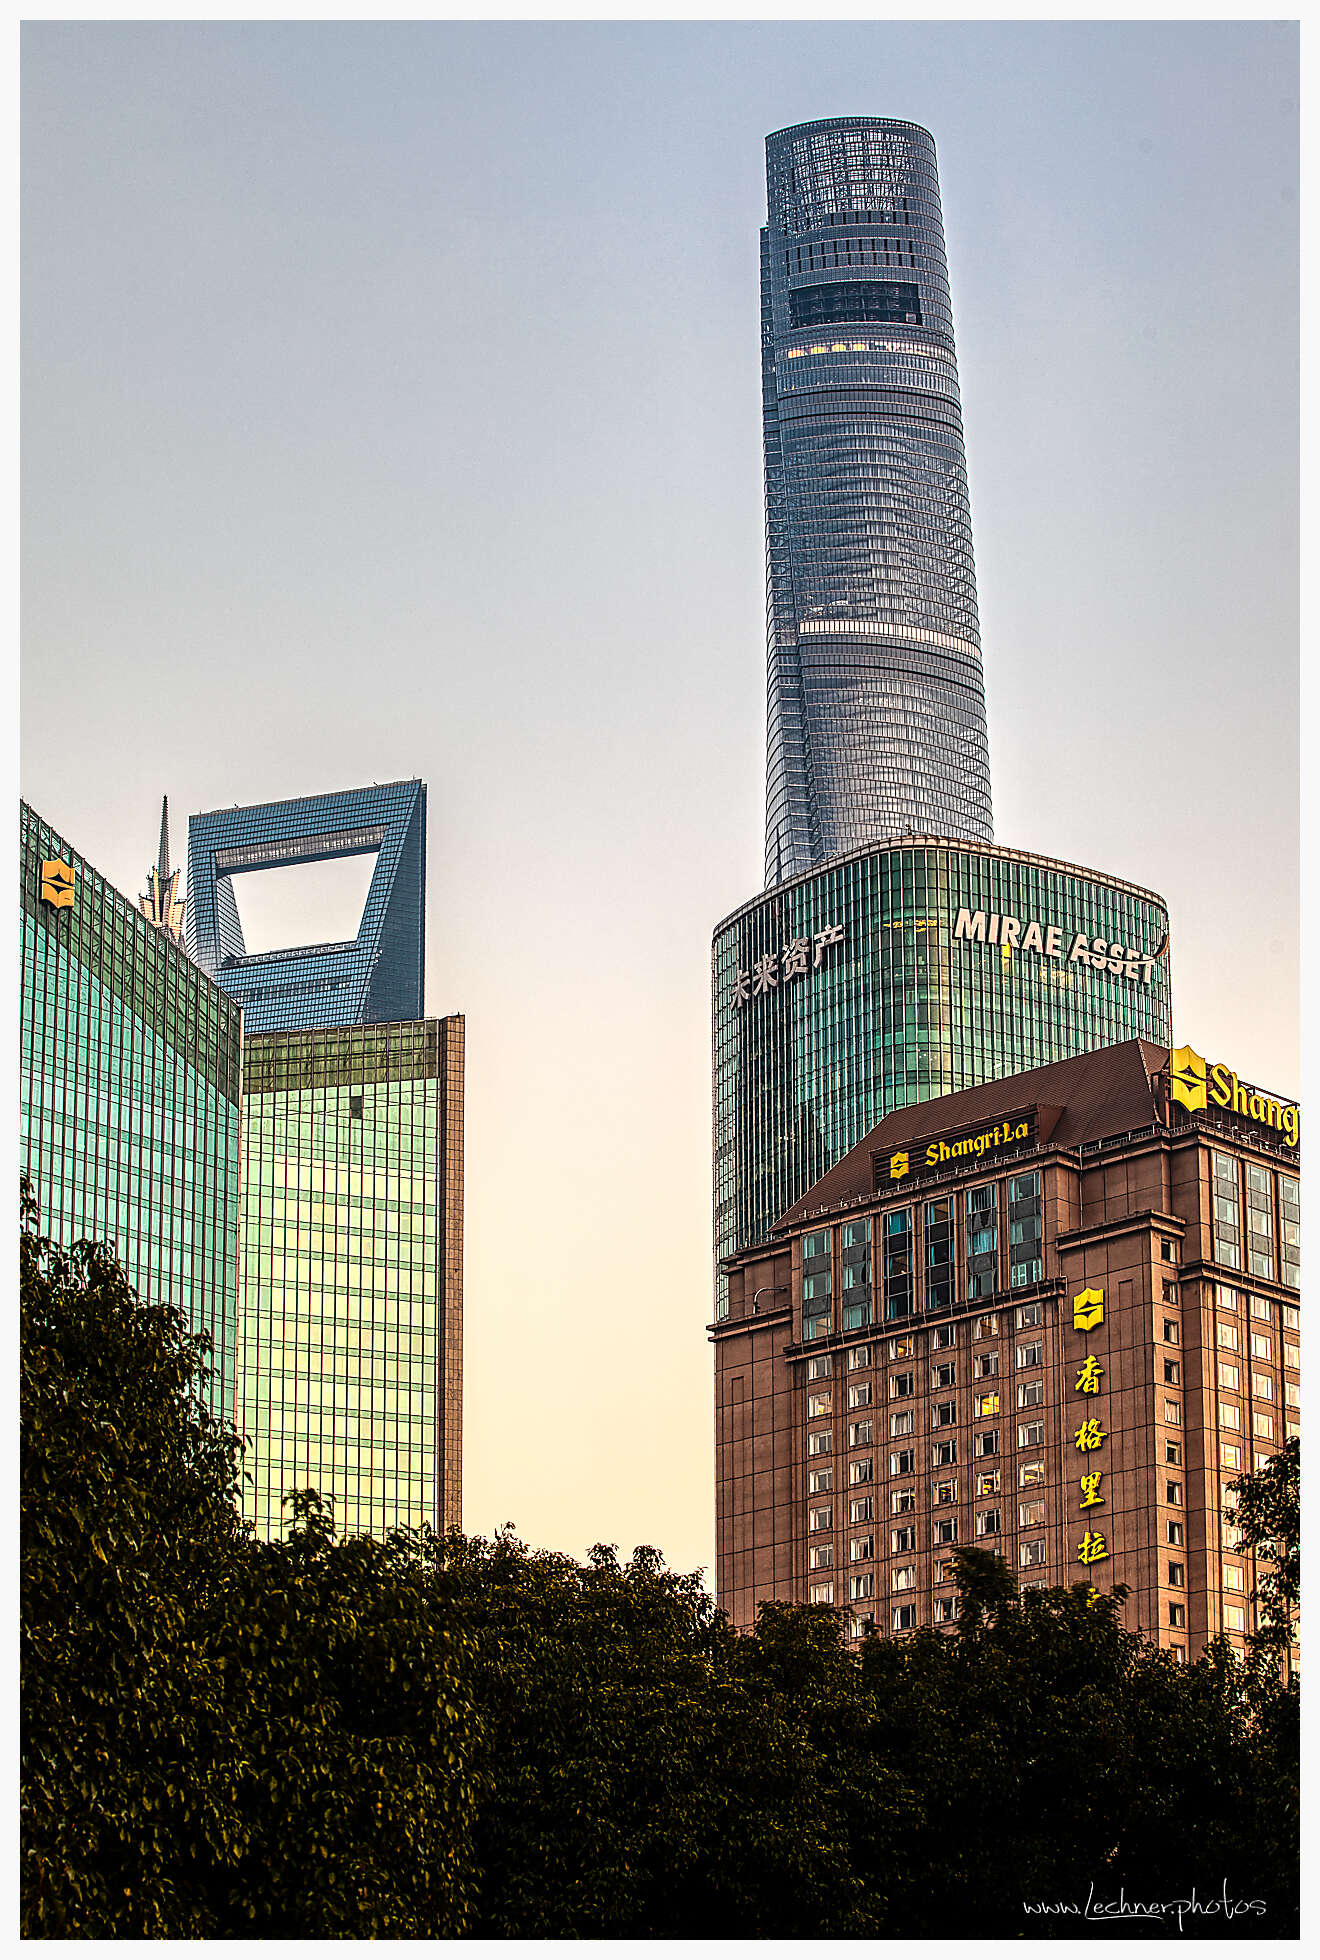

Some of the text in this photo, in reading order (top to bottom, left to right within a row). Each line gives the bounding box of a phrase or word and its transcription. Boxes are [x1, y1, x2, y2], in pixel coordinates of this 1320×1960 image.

[729, 924, 844, 1011] 未来资产
[954, 907, 1155, 984] MIRAE ASSET
[925, 1122, 1029, 1166] Shangri-La
[1208, 1063, 1300, 1147] Shang
[1075, 1355, 1110, 1608] 香格里拉
